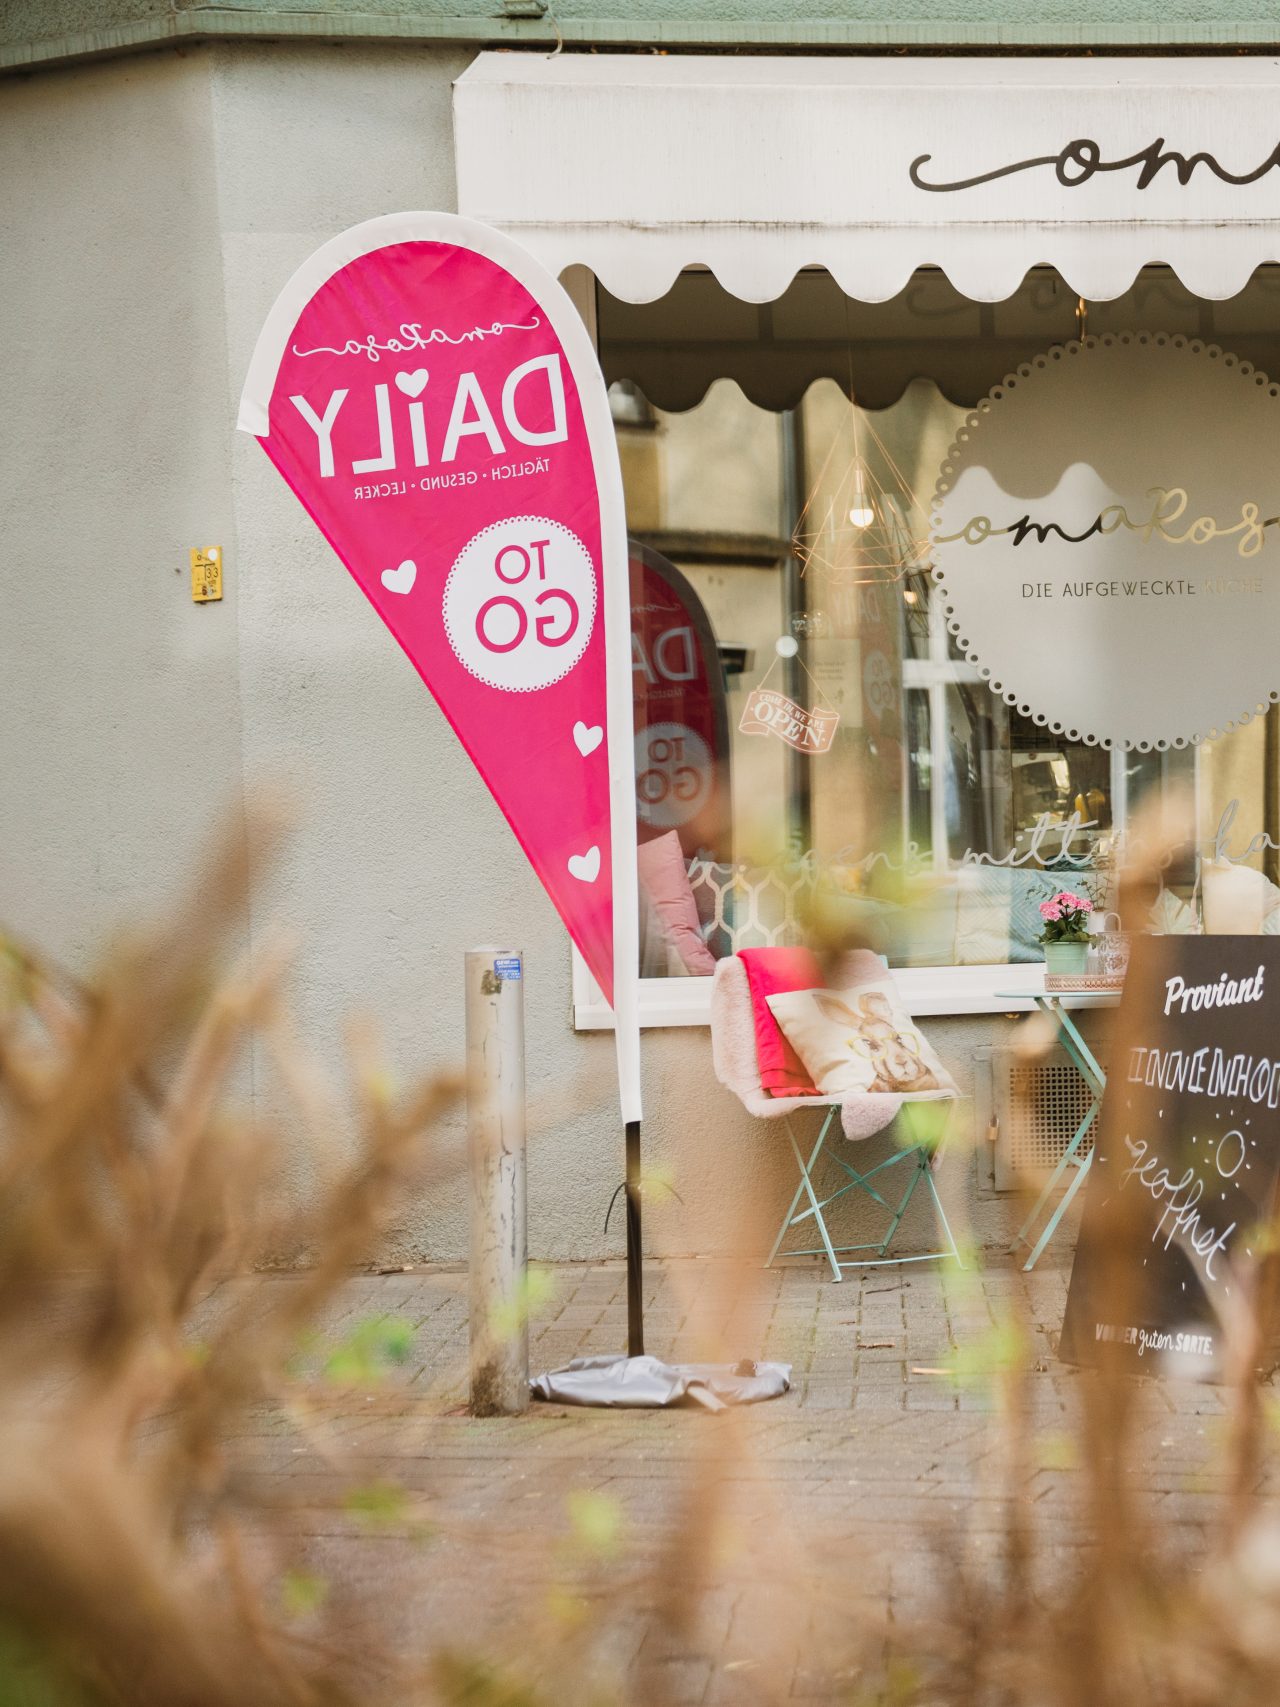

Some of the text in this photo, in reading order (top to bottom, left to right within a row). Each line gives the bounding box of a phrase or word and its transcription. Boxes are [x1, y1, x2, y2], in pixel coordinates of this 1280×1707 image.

[1021, 582, 1053, 599] DIE
[1062, 580, 1196, 598] AUFGEWECKTE
[753, 701, 826, 748] OPEN
[759, 693, 784, 707] COME
[794, 710, 808, 724] WE
[808, 718, 825, 729] ARE
[1164, 965, 1266, 1016] Proviant
[1137, 1329, 1175, 1357] guten
